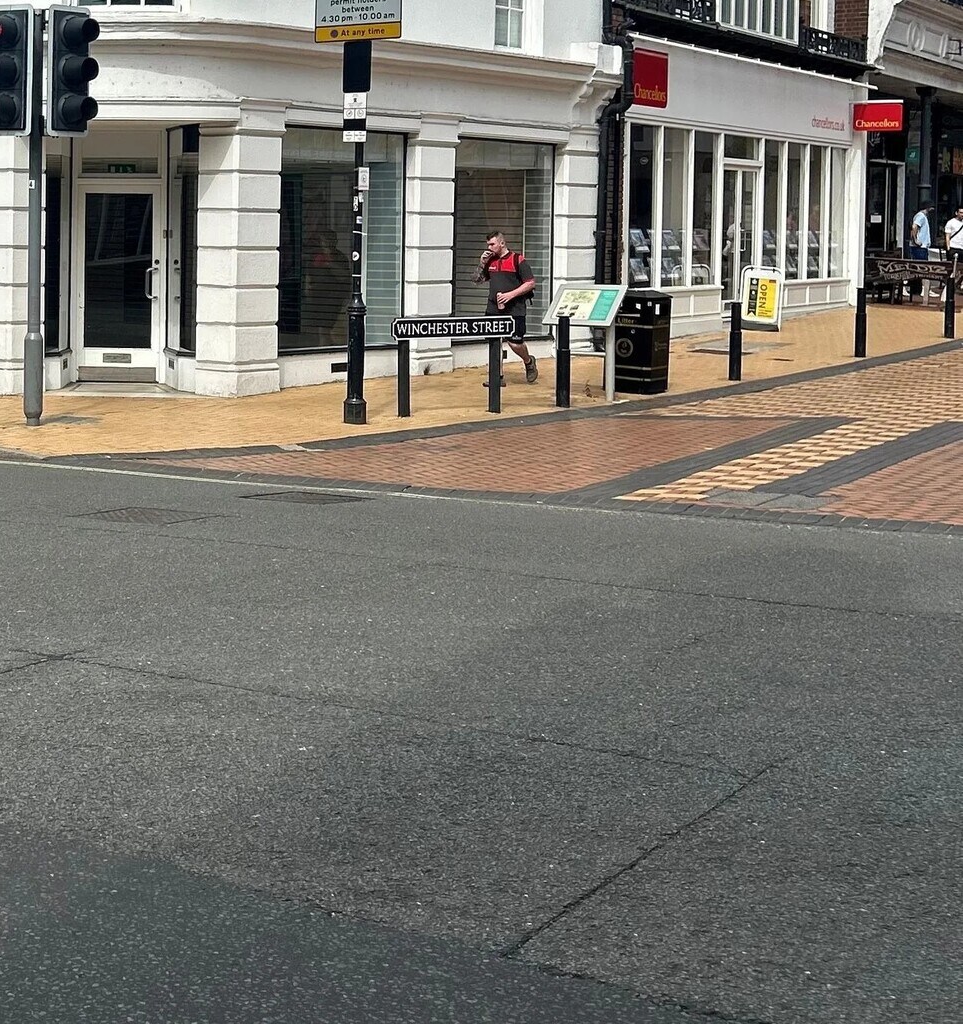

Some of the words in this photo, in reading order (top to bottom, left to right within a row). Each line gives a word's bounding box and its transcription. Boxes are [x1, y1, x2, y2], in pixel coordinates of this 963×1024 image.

[341, 5, 374, 14] between
[341, 15, 353, 23] pm
[352, 29, 366, 37] any
[368, 26, 385, 35] time
[634, 82, 667, 102] Chancellors
[855, 118, 899, 128] Chancellors
[758, 283, 768, 309] OPEN
[396, 323, 470, 335] WINCHESTER
[472, 320, 512, 334] STREET
